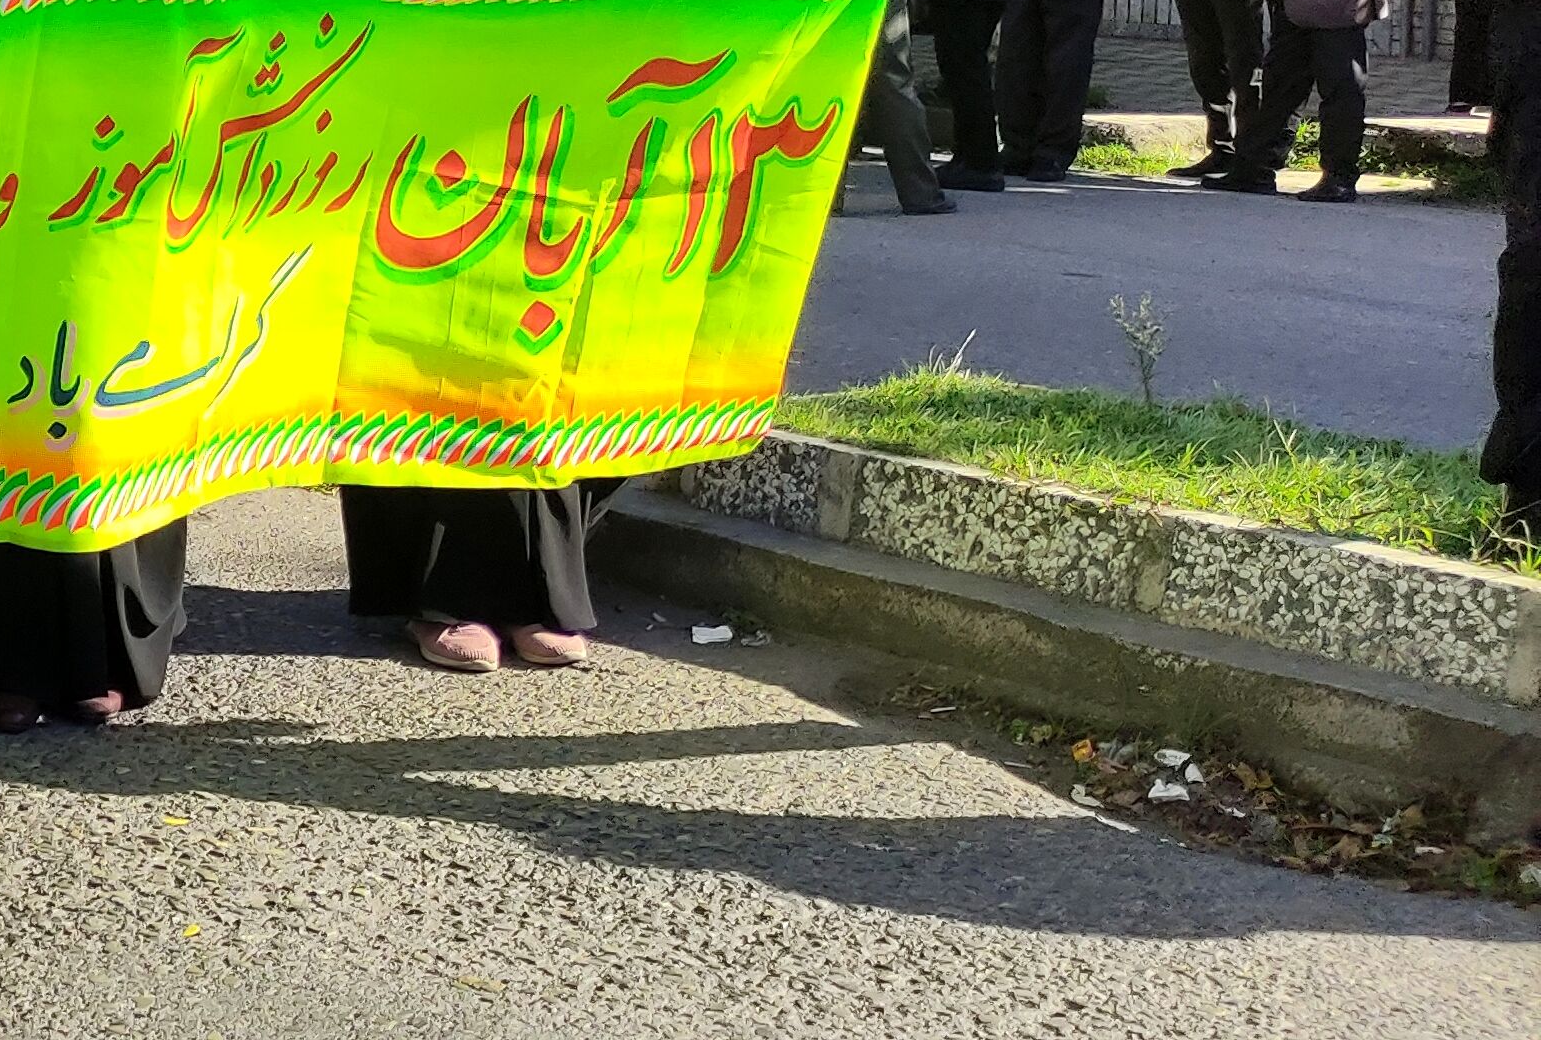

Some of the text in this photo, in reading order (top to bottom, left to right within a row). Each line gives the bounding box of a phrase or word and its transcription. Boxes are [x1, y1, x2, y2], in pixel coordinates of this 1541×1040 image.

[267, 109, 374, 218] روز
[375, 48, 733, 340] آبان
[666, 98, 840, 278] ۱۳
[7, 243, 313, 439] گرامی باد
